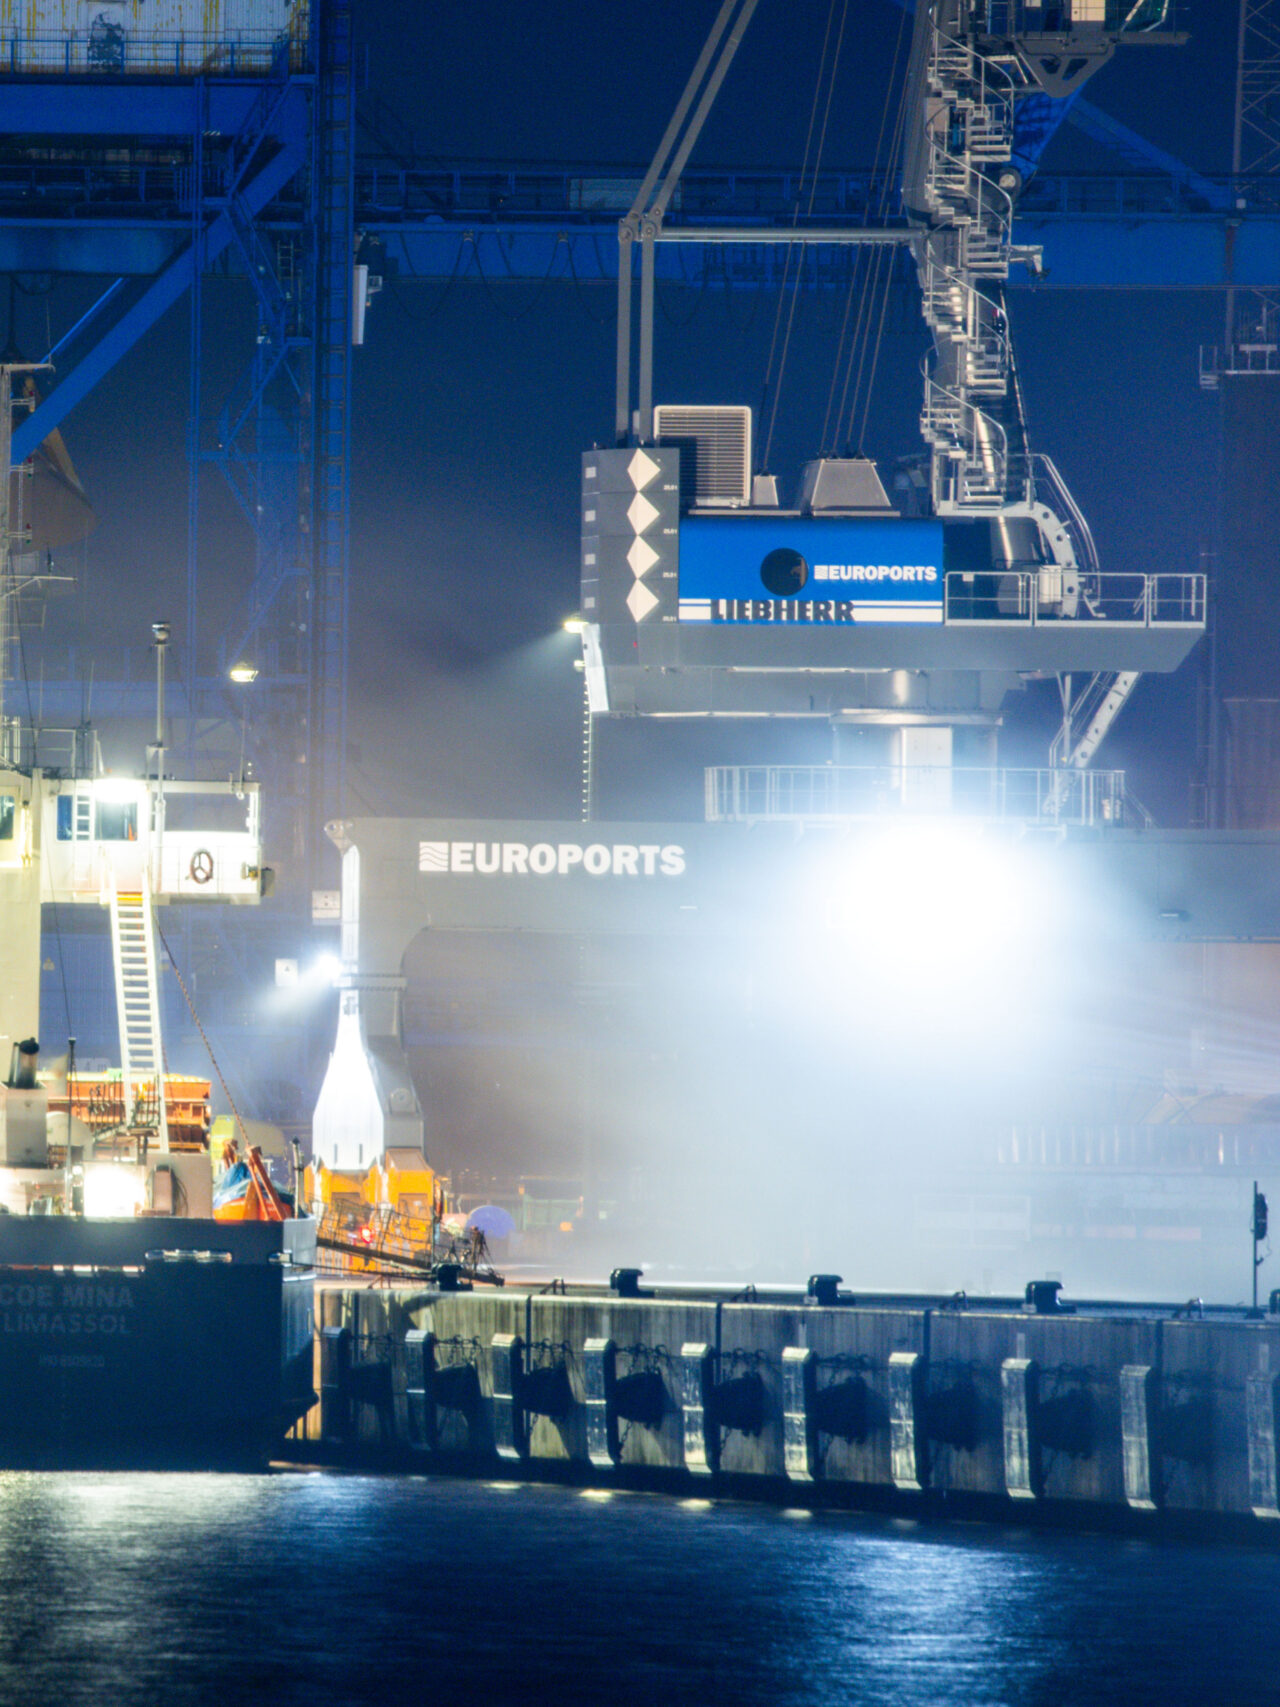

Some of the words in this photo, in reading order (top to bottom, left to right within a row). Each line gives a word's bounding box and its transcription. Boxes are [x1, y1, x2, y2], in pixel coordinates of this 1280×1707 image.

[829, 565, 937, 581] EUROPORTS
[710, 599, 855, 622] LIEBHERR
[451, 842, 686, 875] EUROPORTS
[62, 1284, 135, 1308] MINA
[3, 1311, 132, 1334] LIMASSOL
